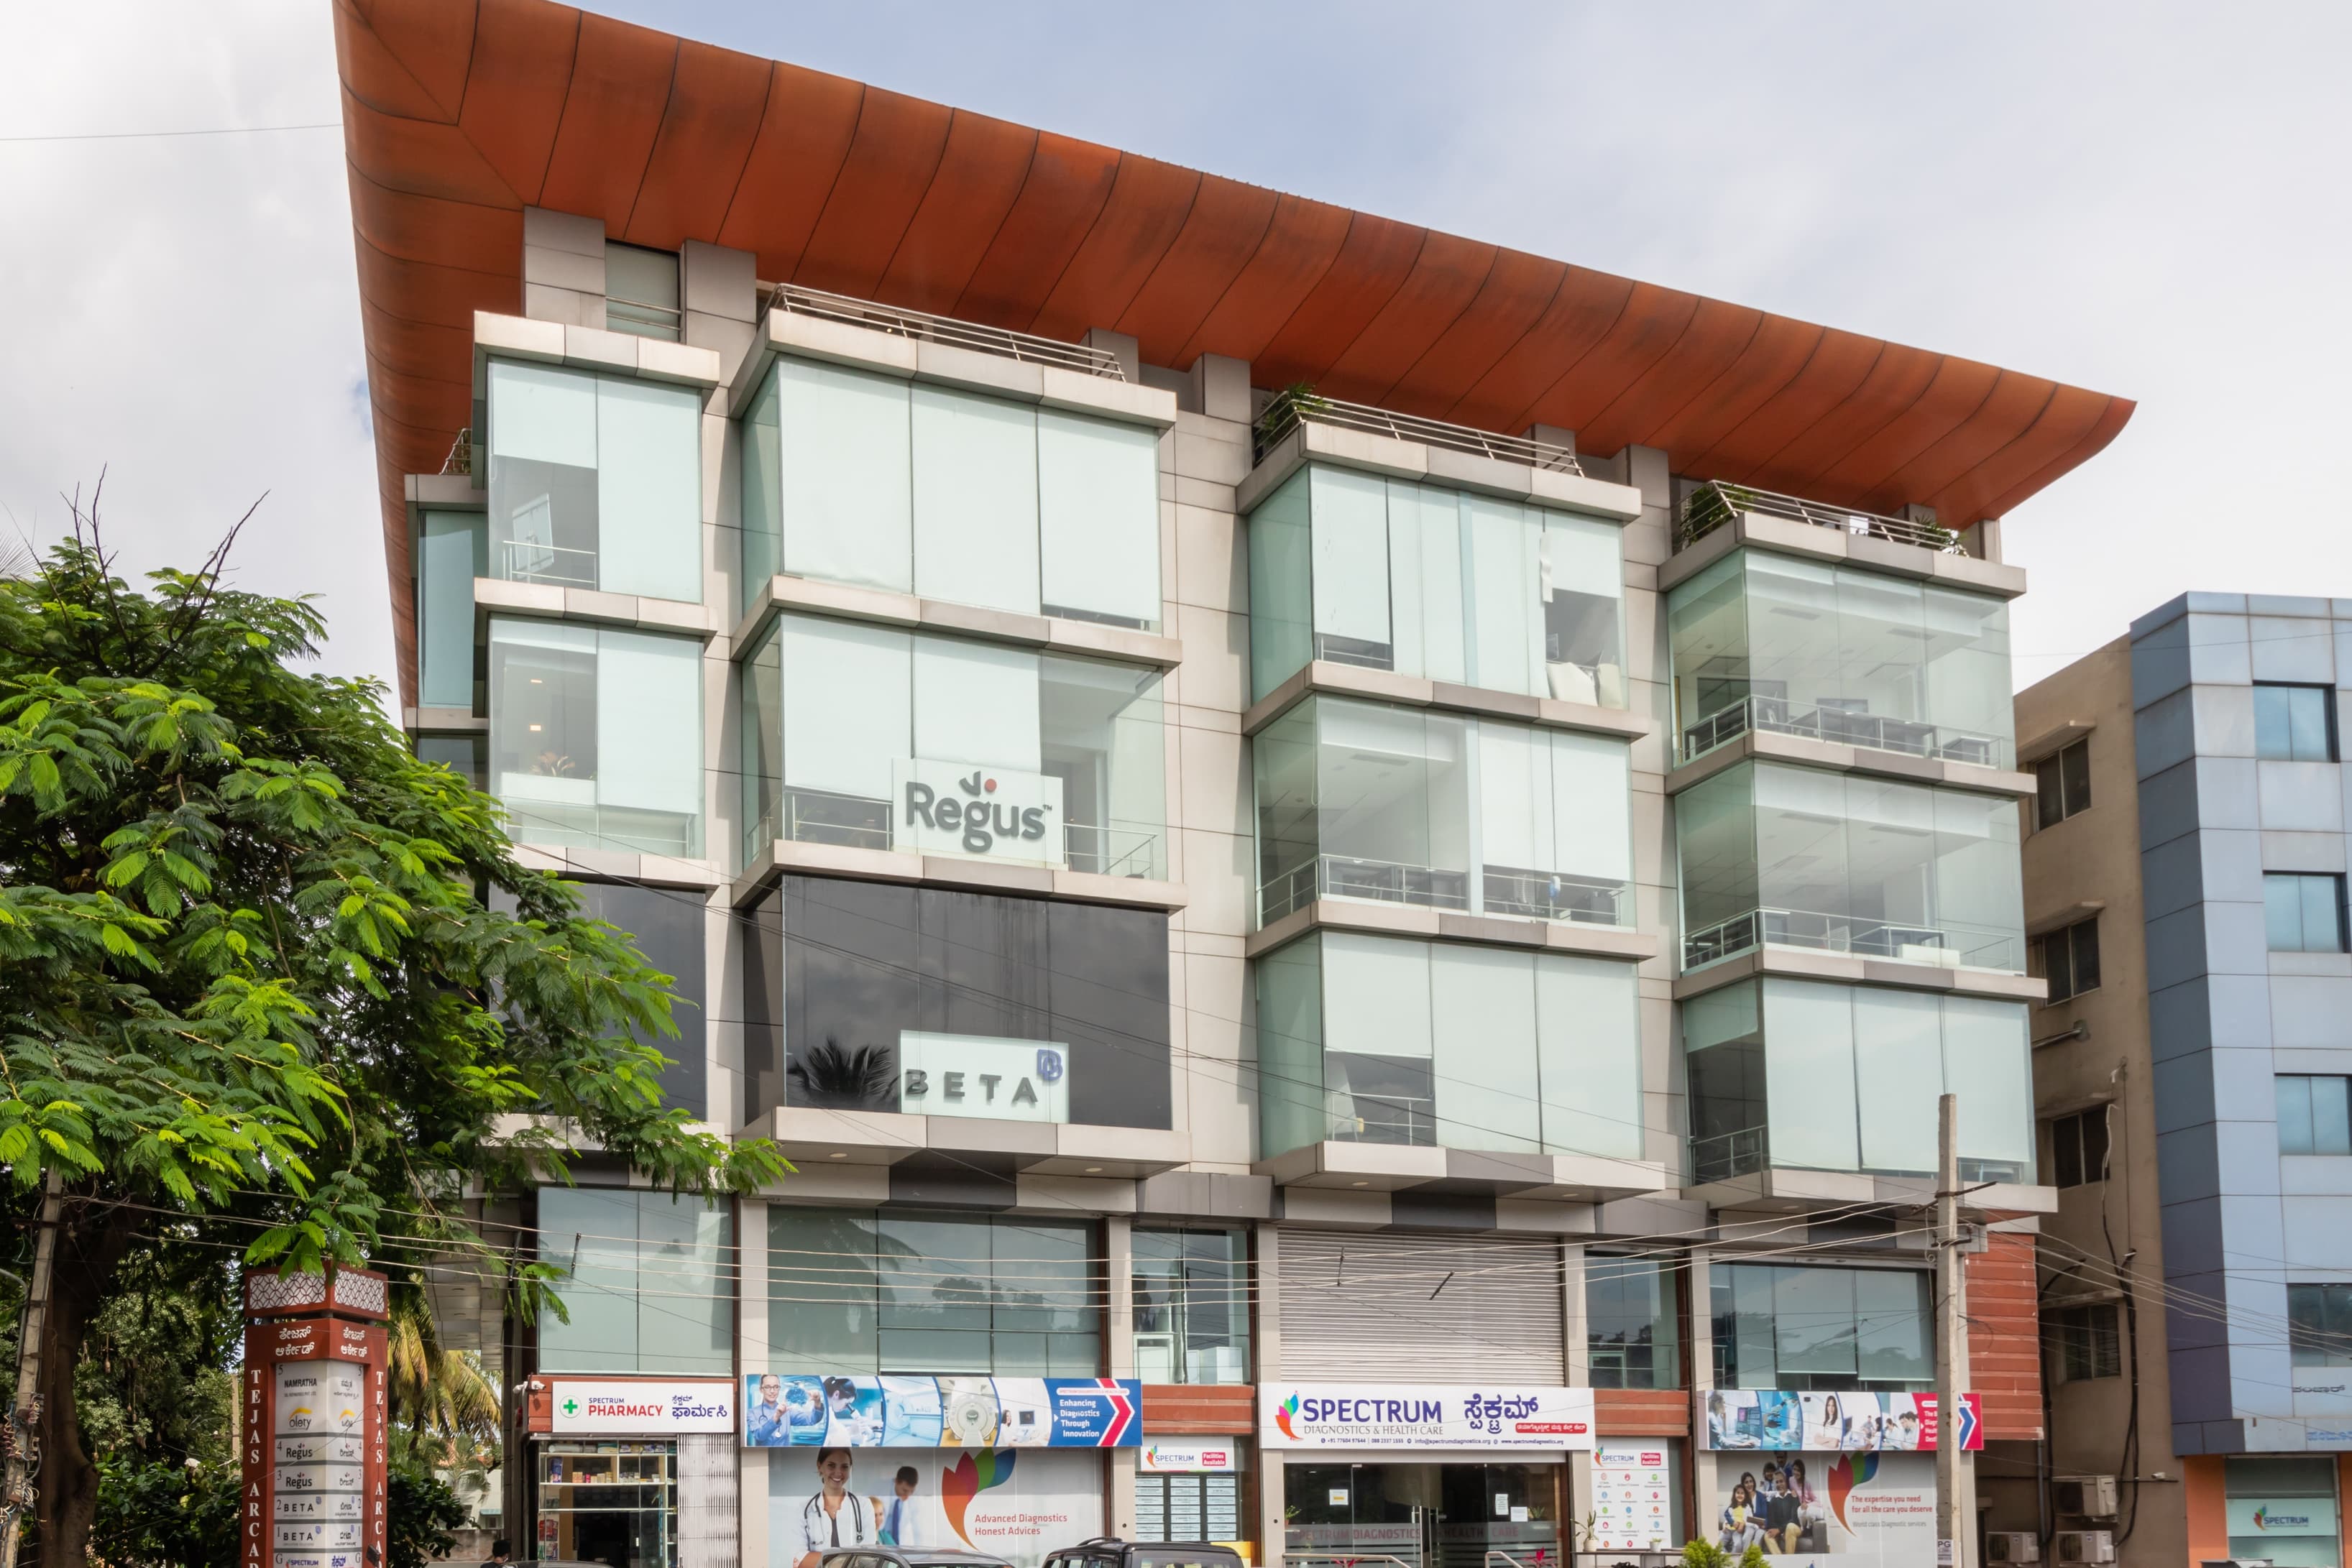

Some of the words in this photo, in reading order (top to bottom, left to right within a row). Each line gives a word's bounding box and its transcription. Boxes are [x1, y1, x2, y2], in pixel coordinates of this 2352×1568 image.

[906, 780, 1045, 853] Regus
[905, 1069, 1039, 1104] BETA
[277, 1364, 283, 1375] 5
[284, 1378, 317, 1388] NAMRATHA
[1060, 1399, 1096, 1408] Enhancing
[589, 1405, 663, 1416] PHARMACY
[1060, 1409, 1100, 1419] Diagnostics
[1303, 1398, 1442, 1424] SPECTRUM
[1464, 1393, 1538, 1434] ಸ್ಪೆಕ್ಟ್ರಮ್
[250, 1369, 261, 1464] TEJAS
[375, 1371, 384, 1463] TEJAS
[289, 1416, 311, 1431] olety
[1060, 1419, 1090, 1429] Through
[1304, 1425, 1370, 1435] DIAGNOSTICS
[1374, 1426, 1379, 1435] &
[1383, 1425, 1417, 1435] HEALTH
[1420, 1426, 1443, 1435] CARE
[277, 1441, 282, 1451] 4
[286, 1447, 313, 1459] Regus
[277, 1470, 282, 1480] 3
[285, 1477, 312, 1489] Regus
[277, 1499, 282, 1510] 2
[1865, 1495, 1892, 1504] expertise
[284, 1503, 314, 1512] BETA
[975, 1514, 1016, 1523] Advanced
[1019, 1513, 1067, 1524] Diagnostics
[1008, 1526, 1041, 1535] Advices
[1354, 1528, 1420, 1539] DIAGNOSTICS
[283, 1532, 313, 1541] BETA
[275, 1553, 282, 1564] G
[355, 1553, 361, 1564] G
